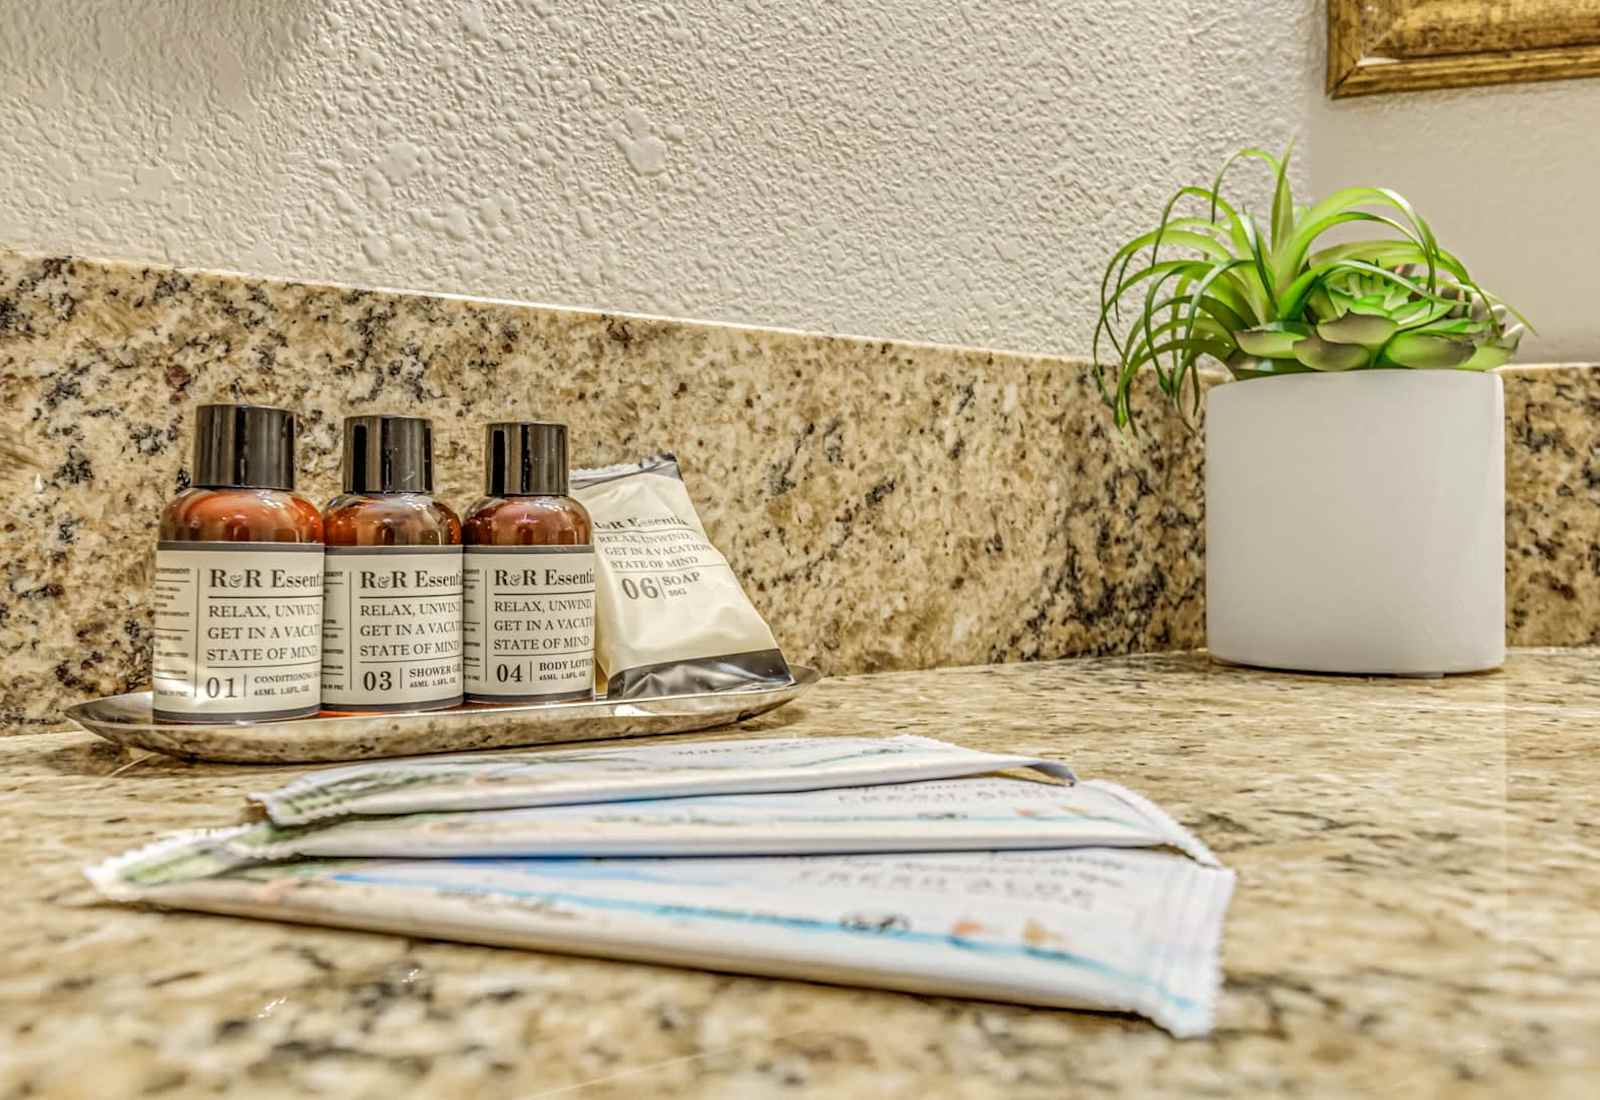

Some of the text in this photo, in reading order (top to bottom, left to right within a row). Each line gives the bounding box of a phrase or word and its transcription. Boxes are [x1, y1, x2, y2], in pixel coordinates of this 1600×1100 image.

[604, 547, 628, 556] GET
[610, 556, 699, 569] STATE OF MIND
[208, 568, 263, 589] R&R
[359, 570, 408, 589] R&R
[494, 568, 538, 587] R&R
[621, 571, 701, 600] 06 SOAP
[208, 605, 272, 619] RELAX,
[359, 604, 416, 617] RELAX,
[494, 601, 545, 614] RELAX,
[359, 625, 393, 637] GET
[396, 624, 413, 636] IN
[416, 623, 426, 635] A
[494, 620, 523, 632] GET
[526, 619, 542, 631] IN
[545, 619, 555, 631] A
[207, 626, 244, 640] GET
[248, 626, 267, 640] IN
[270, 626, 281, 640] A
[359, 644, 411, 657] STATE
[413, 642, 432, 655] OF
[493, 640, 540, 651] STATE
[542, 638, 561, 649] OF
[563, 635, 590, 649] MIND
[206, 649, 264, 661] STATE
[266, 648, 289, 660] OF
[363, 671, 393, 692] 03
[408, 664, 451, 678] SHOWER
[496, 663, 523, 683] 04
[539, 660, 569, 672] BODY
[206, 676, 238, 699] 01
